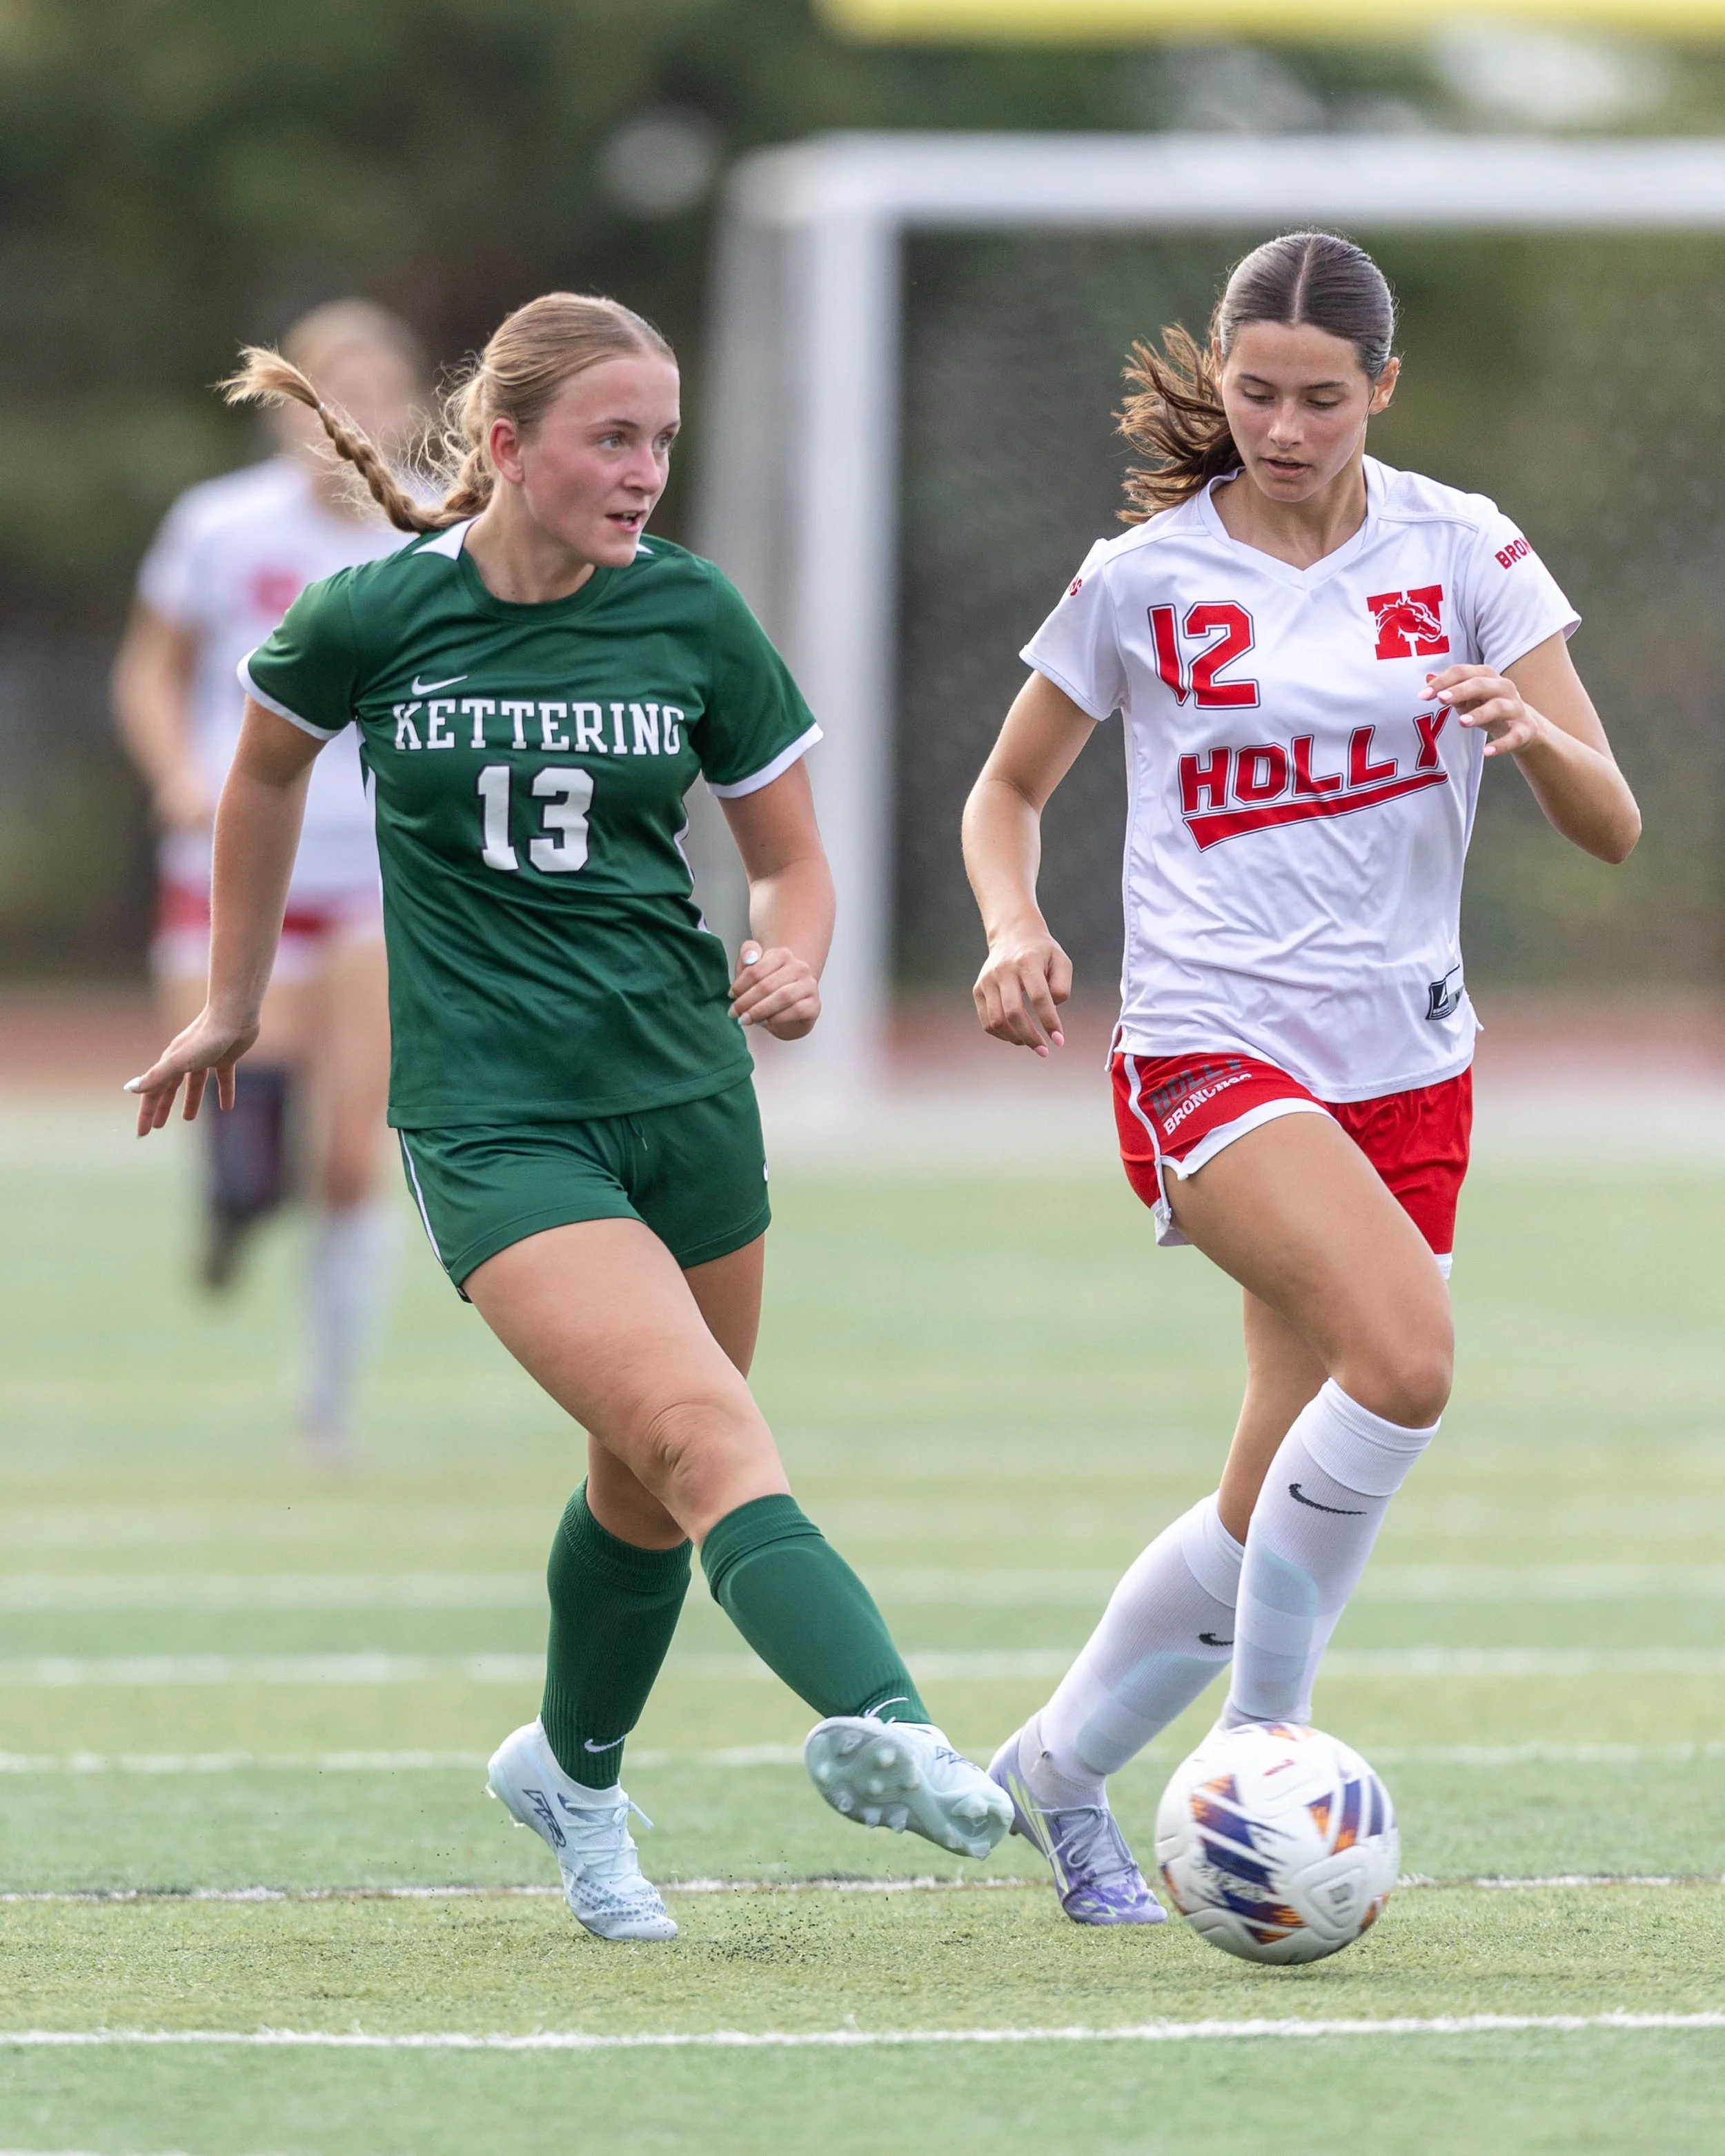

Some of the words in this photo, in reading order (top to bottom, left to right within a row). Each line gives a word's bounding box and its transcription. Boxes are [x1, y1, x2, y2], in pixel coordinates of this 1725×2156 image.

[1147, 600, 1261, 709] 12
[392, 698, 685, 755] KETTERING
[1178, 704, 1452, 815] HOLLY
[476, 764, 595, 873] 13
